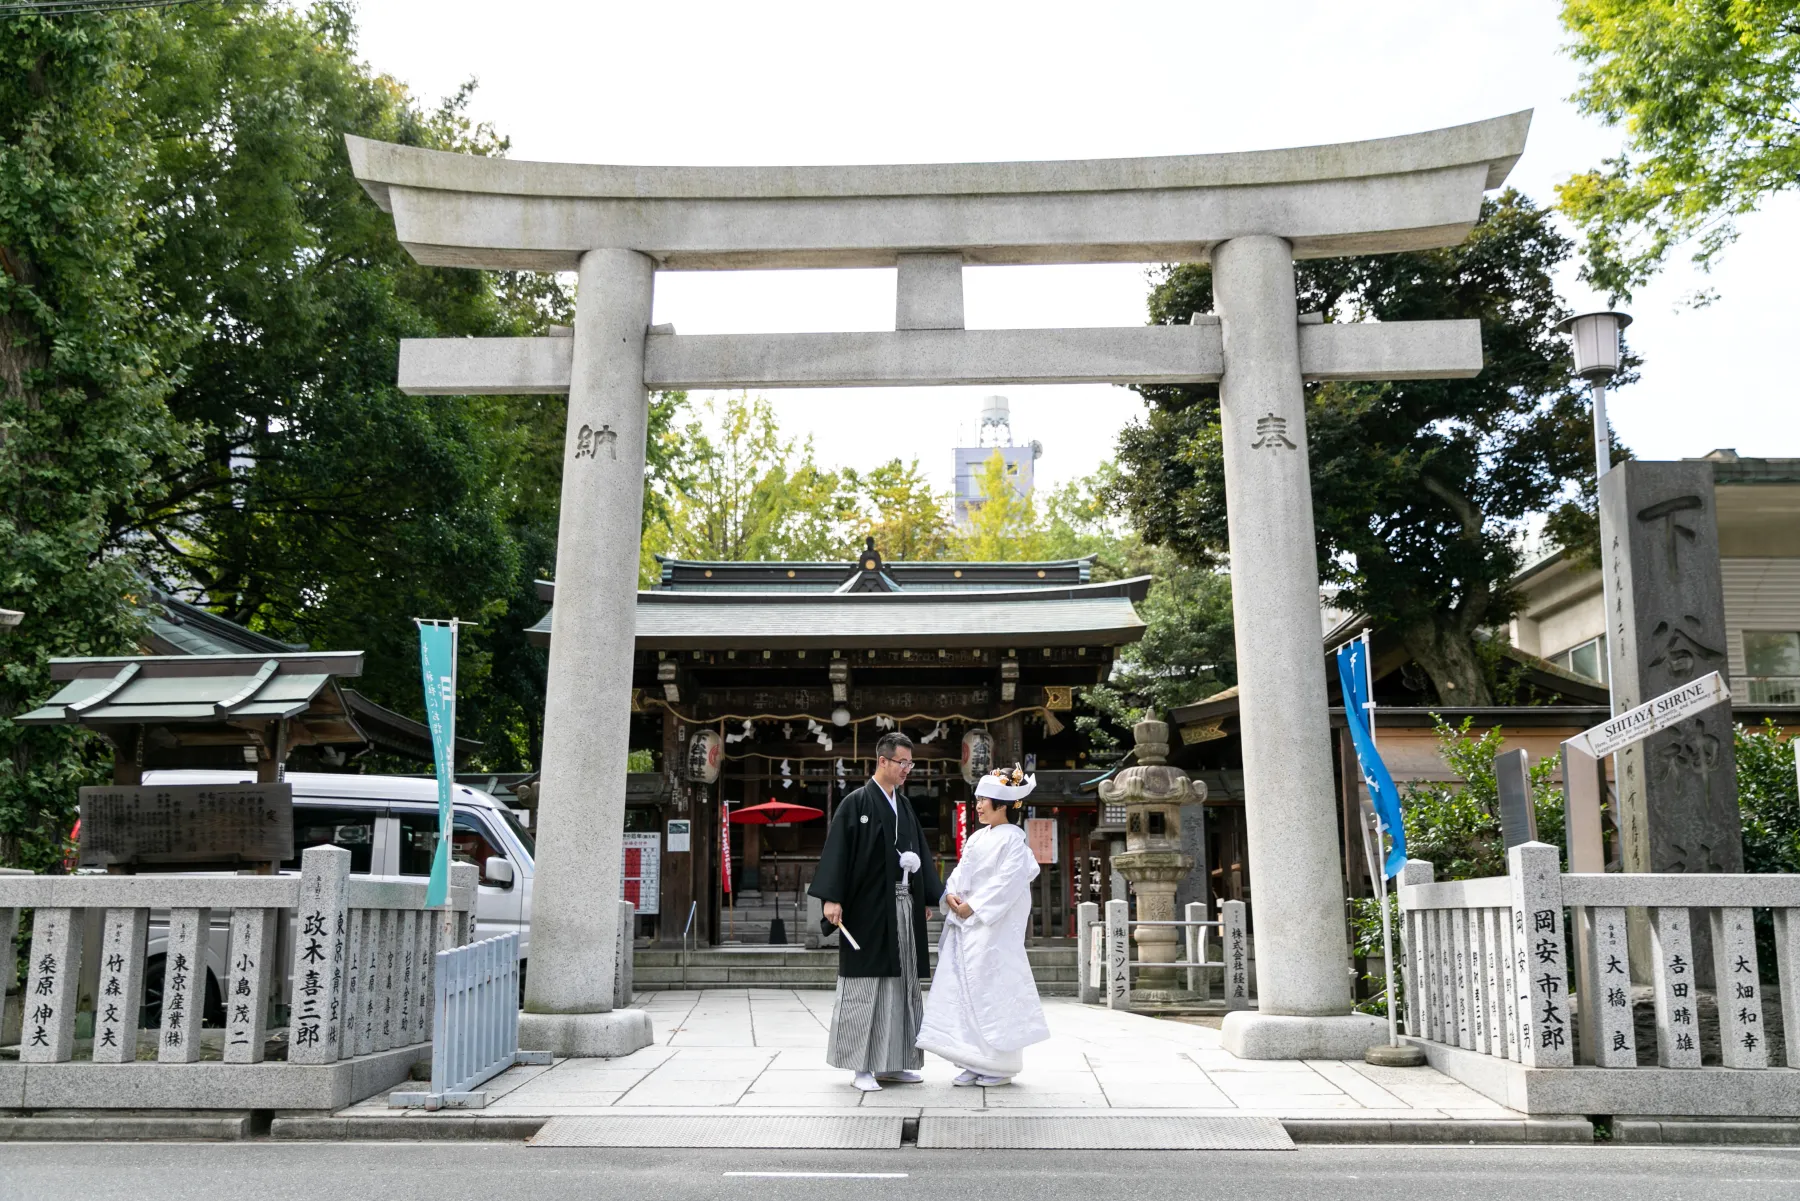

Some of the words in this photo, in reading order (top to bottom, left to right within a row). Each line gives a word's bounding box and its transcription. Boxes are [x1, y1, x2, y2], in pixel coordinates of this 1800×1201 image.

[575, 424, 617, 460] 納
[1251, 412, 1297, 456] 奉
[1605, 706, 1654, 738] SHITAYA
[1657, 684, 1704, 713] SHRINE
[1637, 495, 1728, 872] 下谷神
[30, 953, 57, 1046] 桑原伸夫
[100, 953, 124, 1047] 竹森文夫
[230, 953, 254, 1045] 小島茂二
[296, 910, 328, 1048] 政木喜三郎
[1516, 910, 1531, 1050] 岡安一男
[1533, 909, 1565, 1051] 岡安市太郎
[1606, 954, 1631, 1052] 大橋良
[1734, 955, 1759, 1052] 大畑和幸
